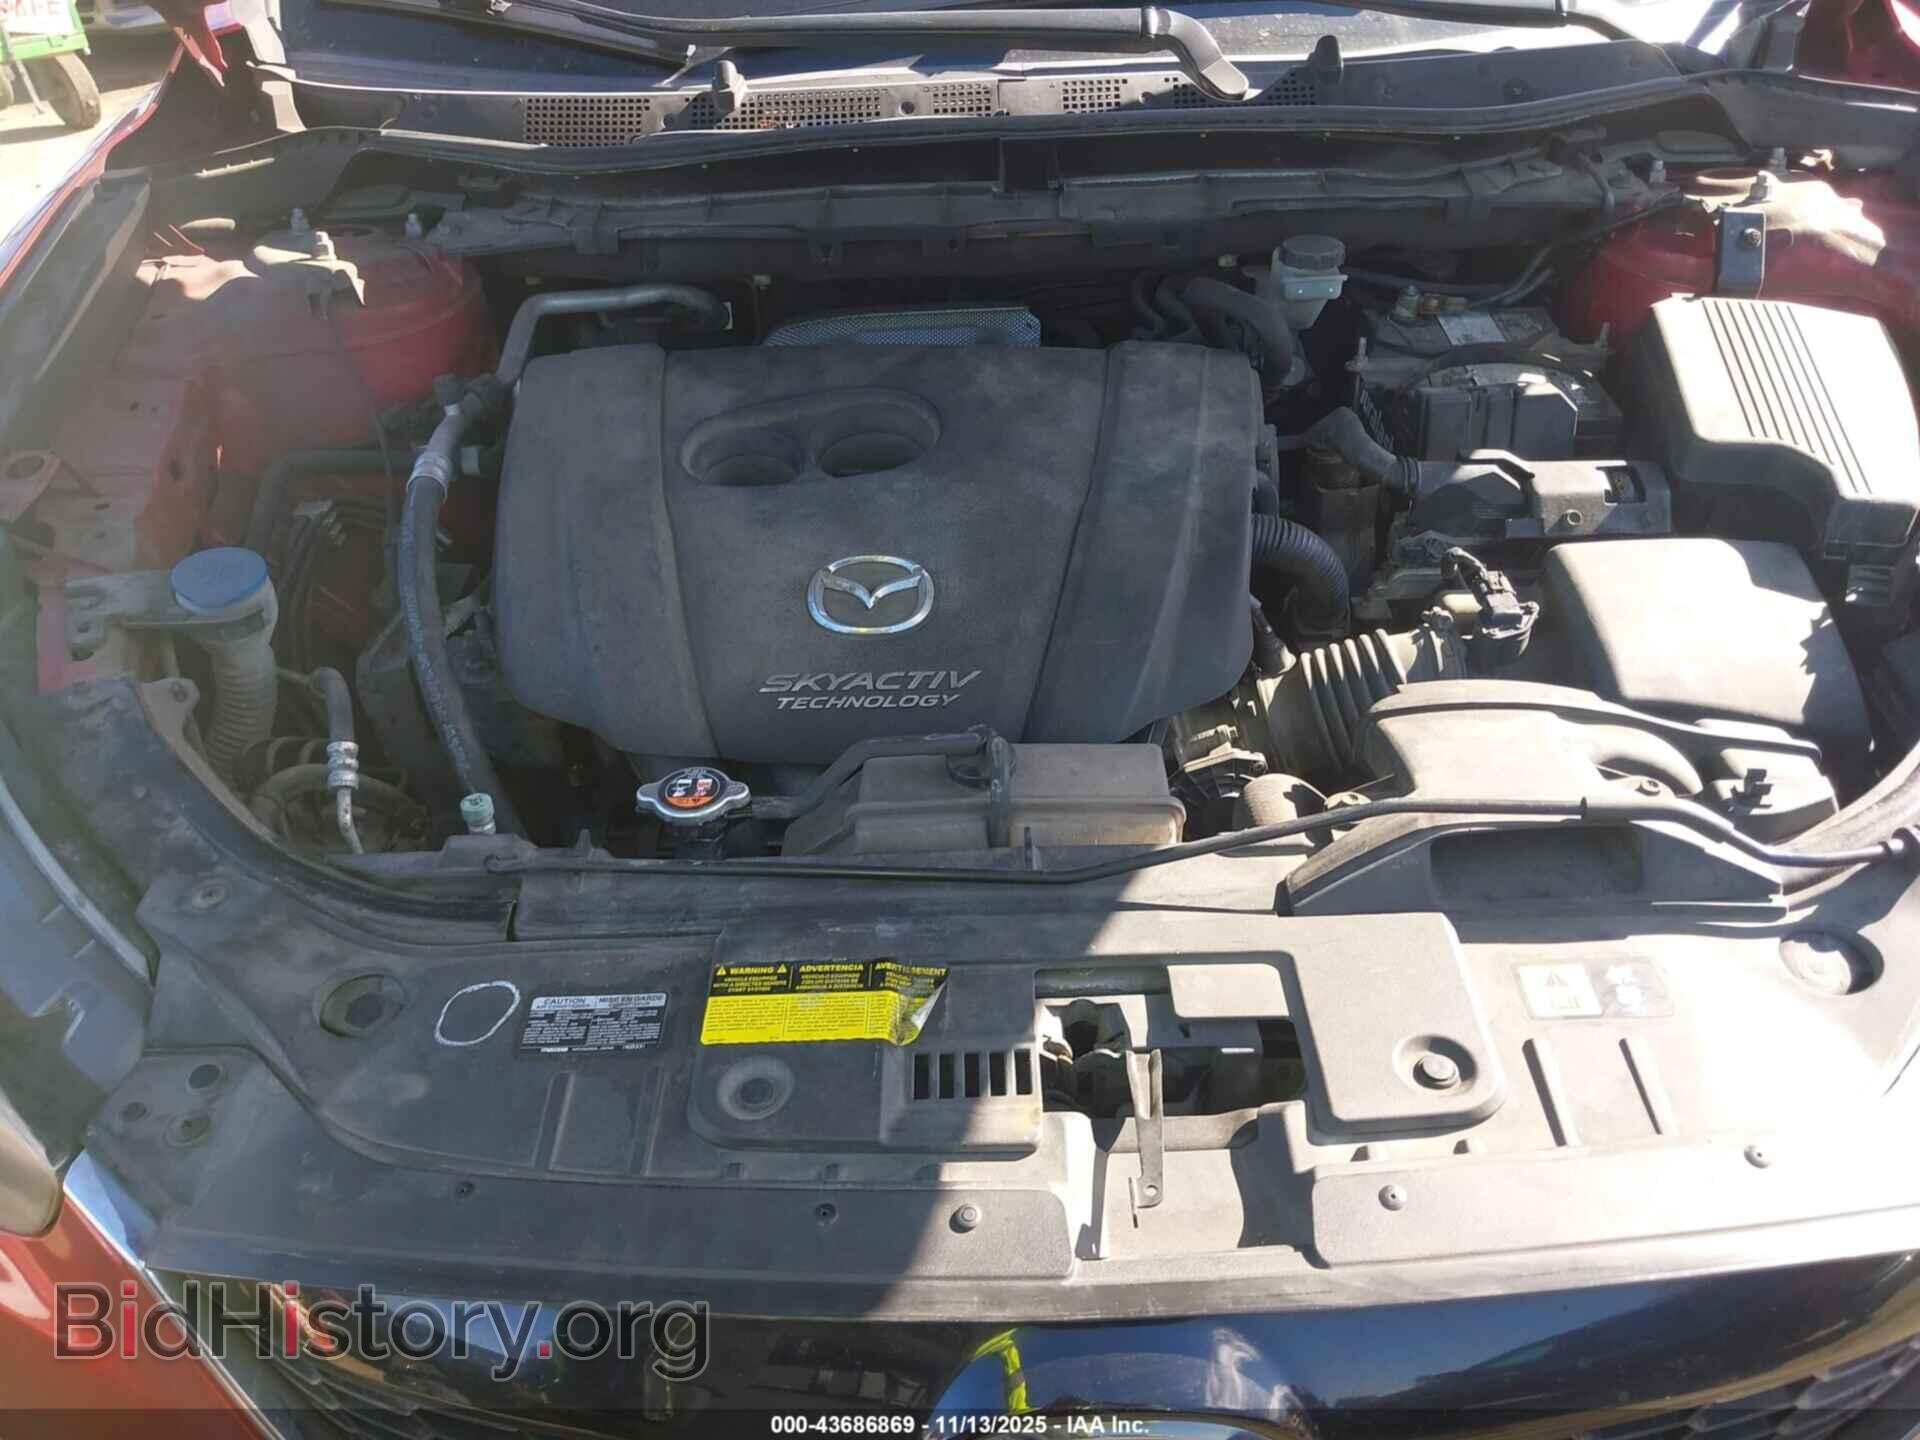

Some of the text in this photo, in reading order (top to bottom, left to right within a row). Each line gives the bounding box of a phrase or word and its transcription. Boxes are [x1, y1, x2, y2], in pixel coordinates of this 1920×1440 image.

[758, 669, 983, 693] SKYACTIV
[776, 694, 961, 711] TECHNOLOGY
[730, 967, 774, 975] WARNING
[799, 964, 864, 972] ADVERTENCIA
[544, 997, 585, 1005] CAUTION
